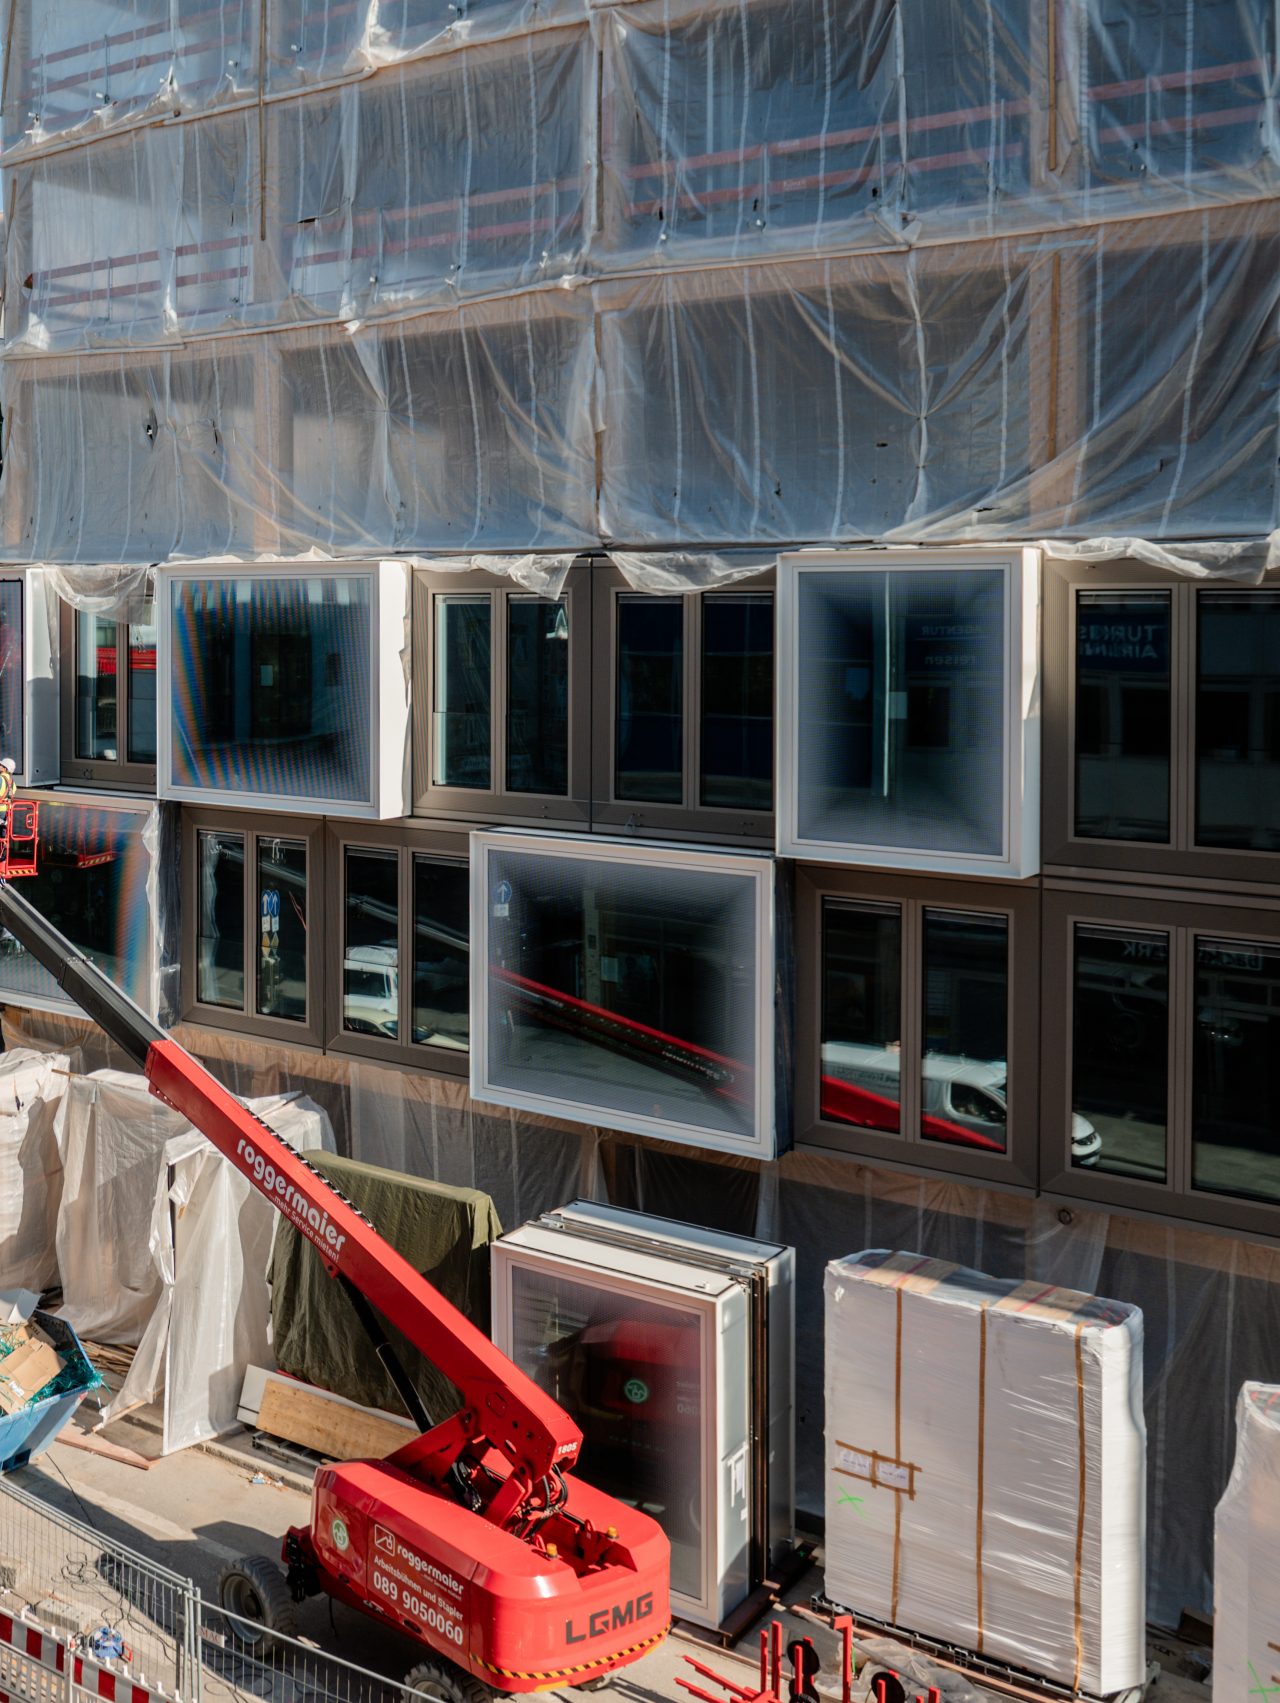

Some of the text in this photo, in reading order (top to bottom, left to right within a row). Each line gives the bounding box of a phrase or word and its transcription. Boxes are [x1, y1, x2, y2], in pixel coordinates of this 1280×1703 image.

[236, 1139, 346, 1251] roggermaier
[291, 1210, 314, 1237] Service
[314, 1235, 340, 1263] mieten!
[557, 1441, 577, 1455] 1805
[374, 1555, 464, 1621] Arbeitsbühnen und Stapler
[397, 1545, 464, 1594] roggermaier
[373, 1571, 464, 1646] 089 9050060
[565, 1591, 654, 1645] LGMG
